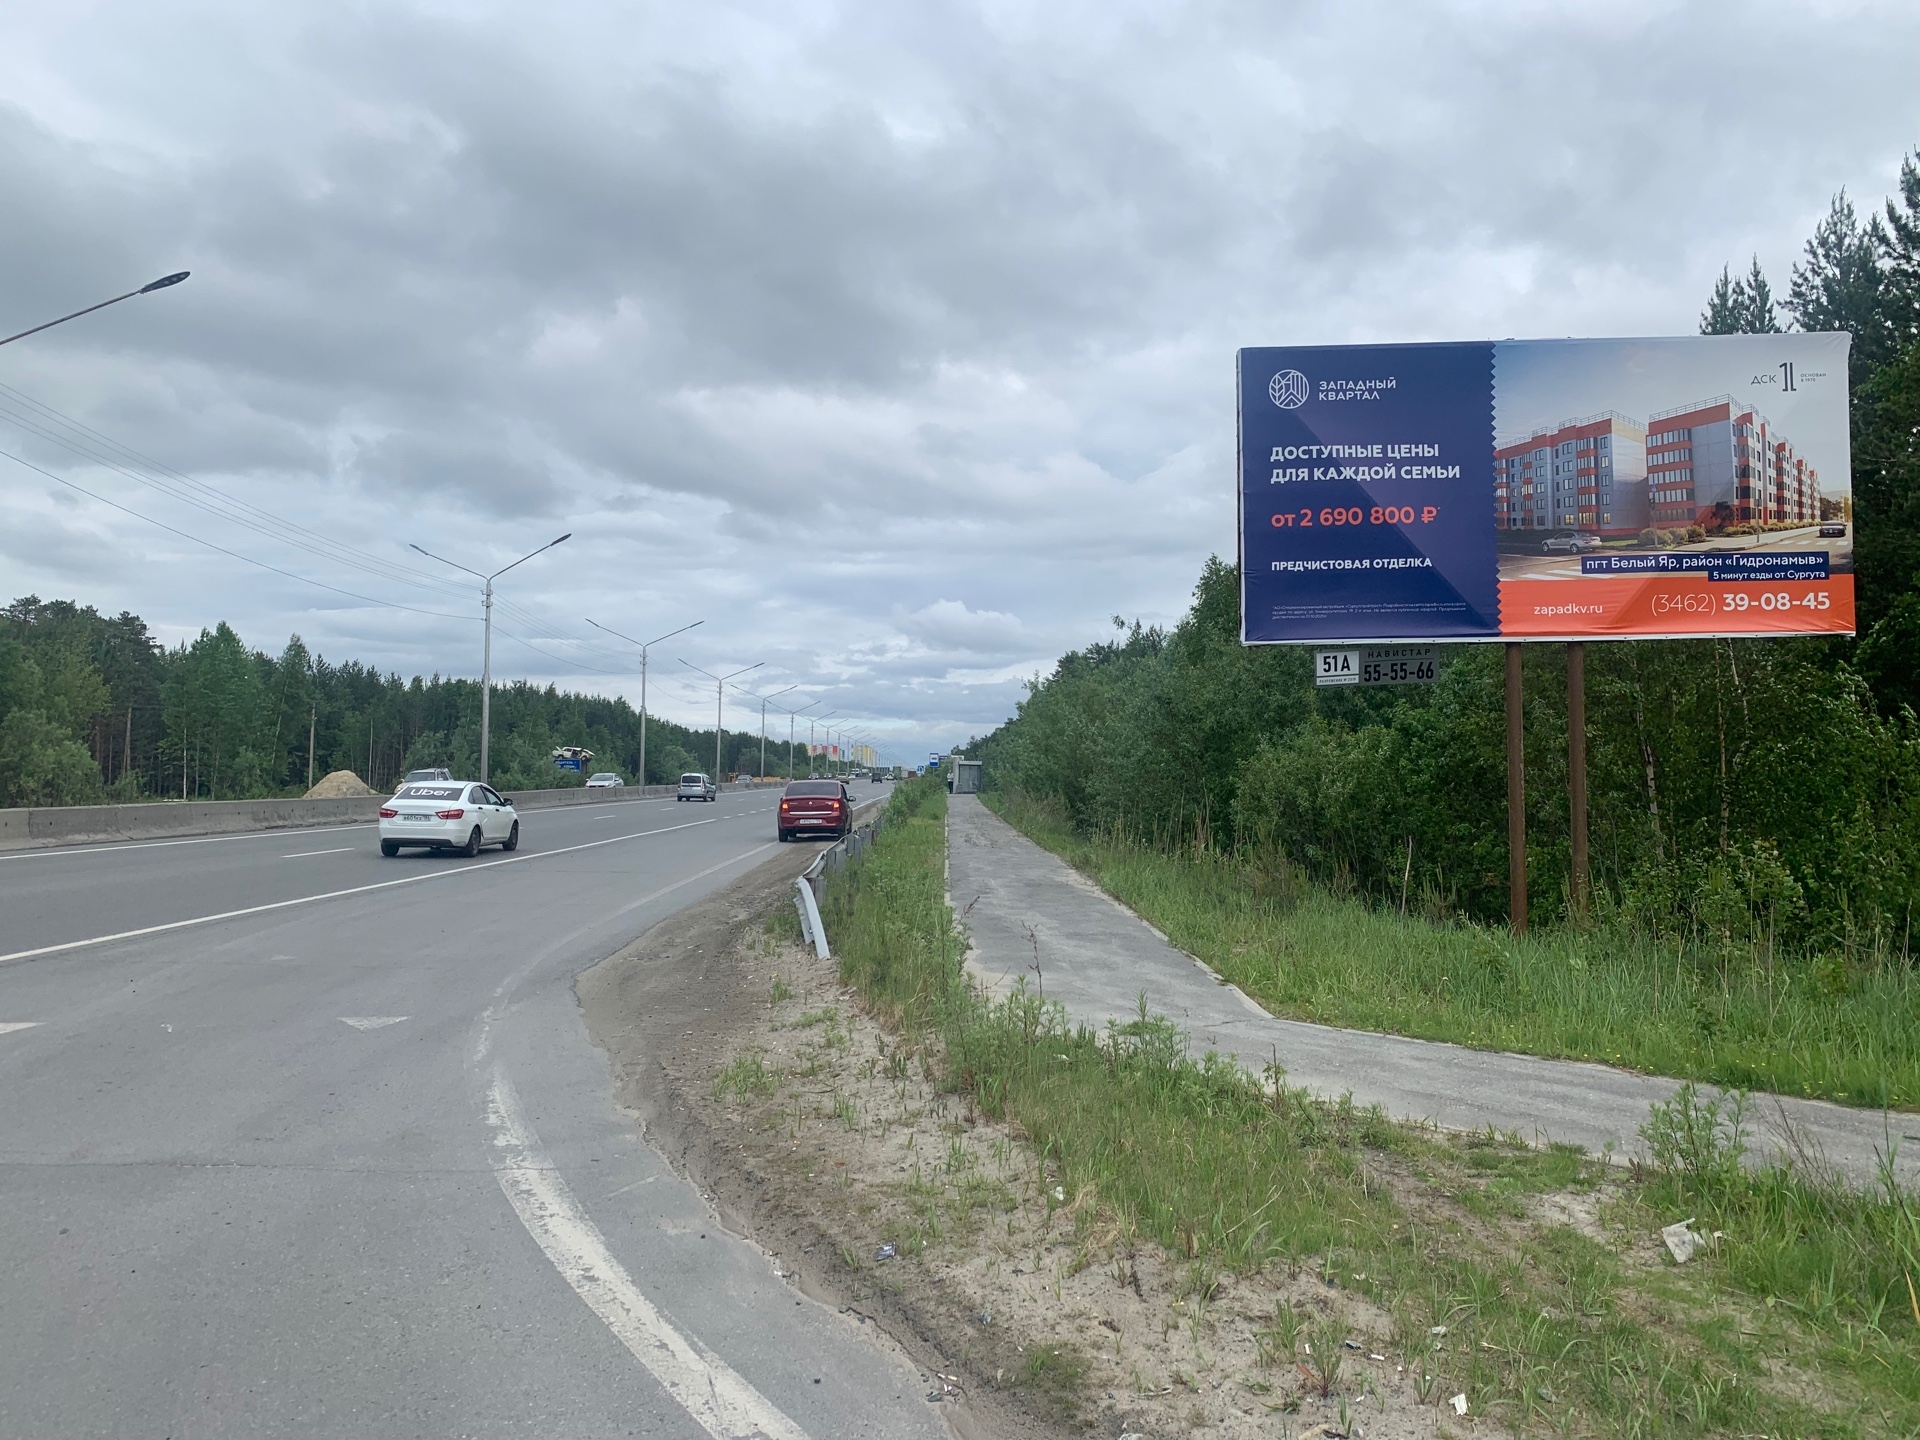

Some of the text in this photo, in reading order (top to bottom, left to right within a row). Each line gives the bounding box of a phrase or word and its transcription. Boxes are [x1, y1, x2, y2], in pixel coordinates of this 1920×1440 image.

[1319, 377, 1396, 390] ЗАПАДНЫЙ
[1750, 374, 1777, 386] ДСК
[1319, 391, 1380, 401] КВАРТАЛ
[1270, 443, 1440, 462] ДОСТУПНЫЕ ЦЕНЫ
[1270, 463, 1460, 484] ДЛЯ КАЖДОЙ СЕМЬИ
[1270, 513, 1296, 528] от
[1299, 509, 1313, 526] 2
[1319, 507, 1364, 526] 690
[1370, 506, 1416, 525] 800
[1271, 557, 1432, 572] ПРЕДЧИСТОВАЯ ОТДЕЛКА
[1586, 554, 1823, 570] пгт Белый Яр, район «Гидронамыв»
[1713, 571, 1720, 579] 5
[1721, 571, 1749, 581] минут
[1750, 571, 1772, 580] езды
[1787, 570, 1826, 581] Сургута
[1533, 603, 1603, 618] zapadkv.ru
[1651, 592, 1830, 617] (3462) 39-08-45
[1367, 648, 1431, 658] НАВИСТАР
[1364, 662, 1434, 682] 55-55-66
[410, 788, 452, 796] Uber
